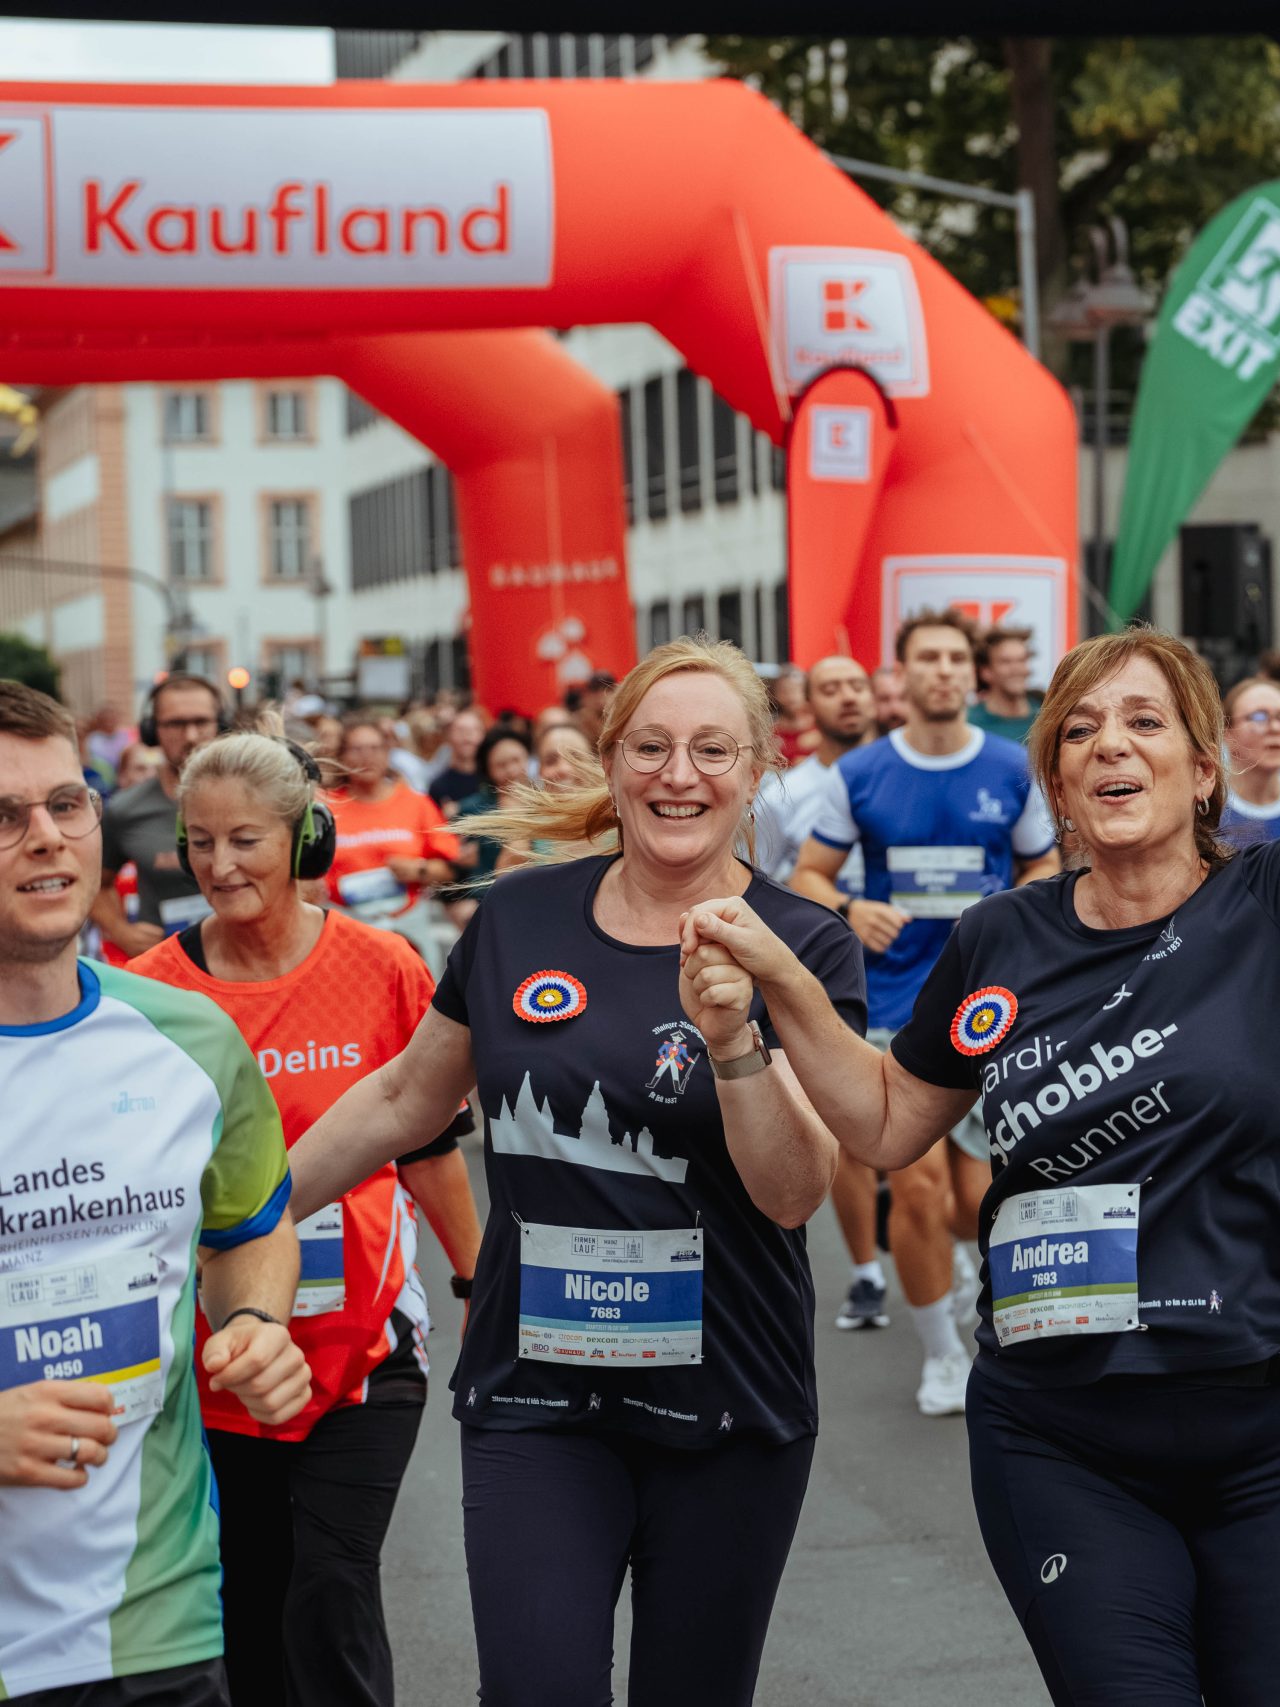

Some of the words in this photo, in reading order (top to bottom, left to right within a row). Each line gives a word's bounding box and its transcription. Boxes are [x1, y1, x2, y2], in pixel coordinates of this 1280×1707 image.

[82, 180, 512, 257] Kaufland
[1173, 291, 1276, 379] EXIT
[1152, 951, 1167, 960] seit
[1167, 936, 1183, 953] 1837
[652, 1022, 677, 1035] Mainzer
[257, 1040, 362, 1078] Deins
[982, 1036, 1068, 1101] ardi
[988, 1023, 1178, 1166] Schobbe-
[1029, 1081, 1171, 1182] Runner
[0, 1158, 105, 1197] Landes
[0, 1185, 185, 1236] krankenhaus
[1020, 1201, 1036, 1210] FIRMEN
[1020, 1209, 1036, 1220] LAUF
[0, 1219, 169, 1253] RHEINHESSEN-FACHKLINIK
[574, 1236, 596, 1244] FIRMEN
[574, 1244, 596, 1254] LAUF
[0, 1251, 44, 1271] MAINZ
[1012, 1239, 1089, 1272] Andrea
[565, 1273, 650, 1302] Nicole
[1032, 1271, 1057, 1287] 7693
[590, 1306, 621, 1319] 7683
[1030, 1304, 1054, 1314] Dexcom
[14, 1317, 103, 1363] Noah
[532, 1343, 549, 1352] BDO
[43, 1358, 83, 1380] 9450
